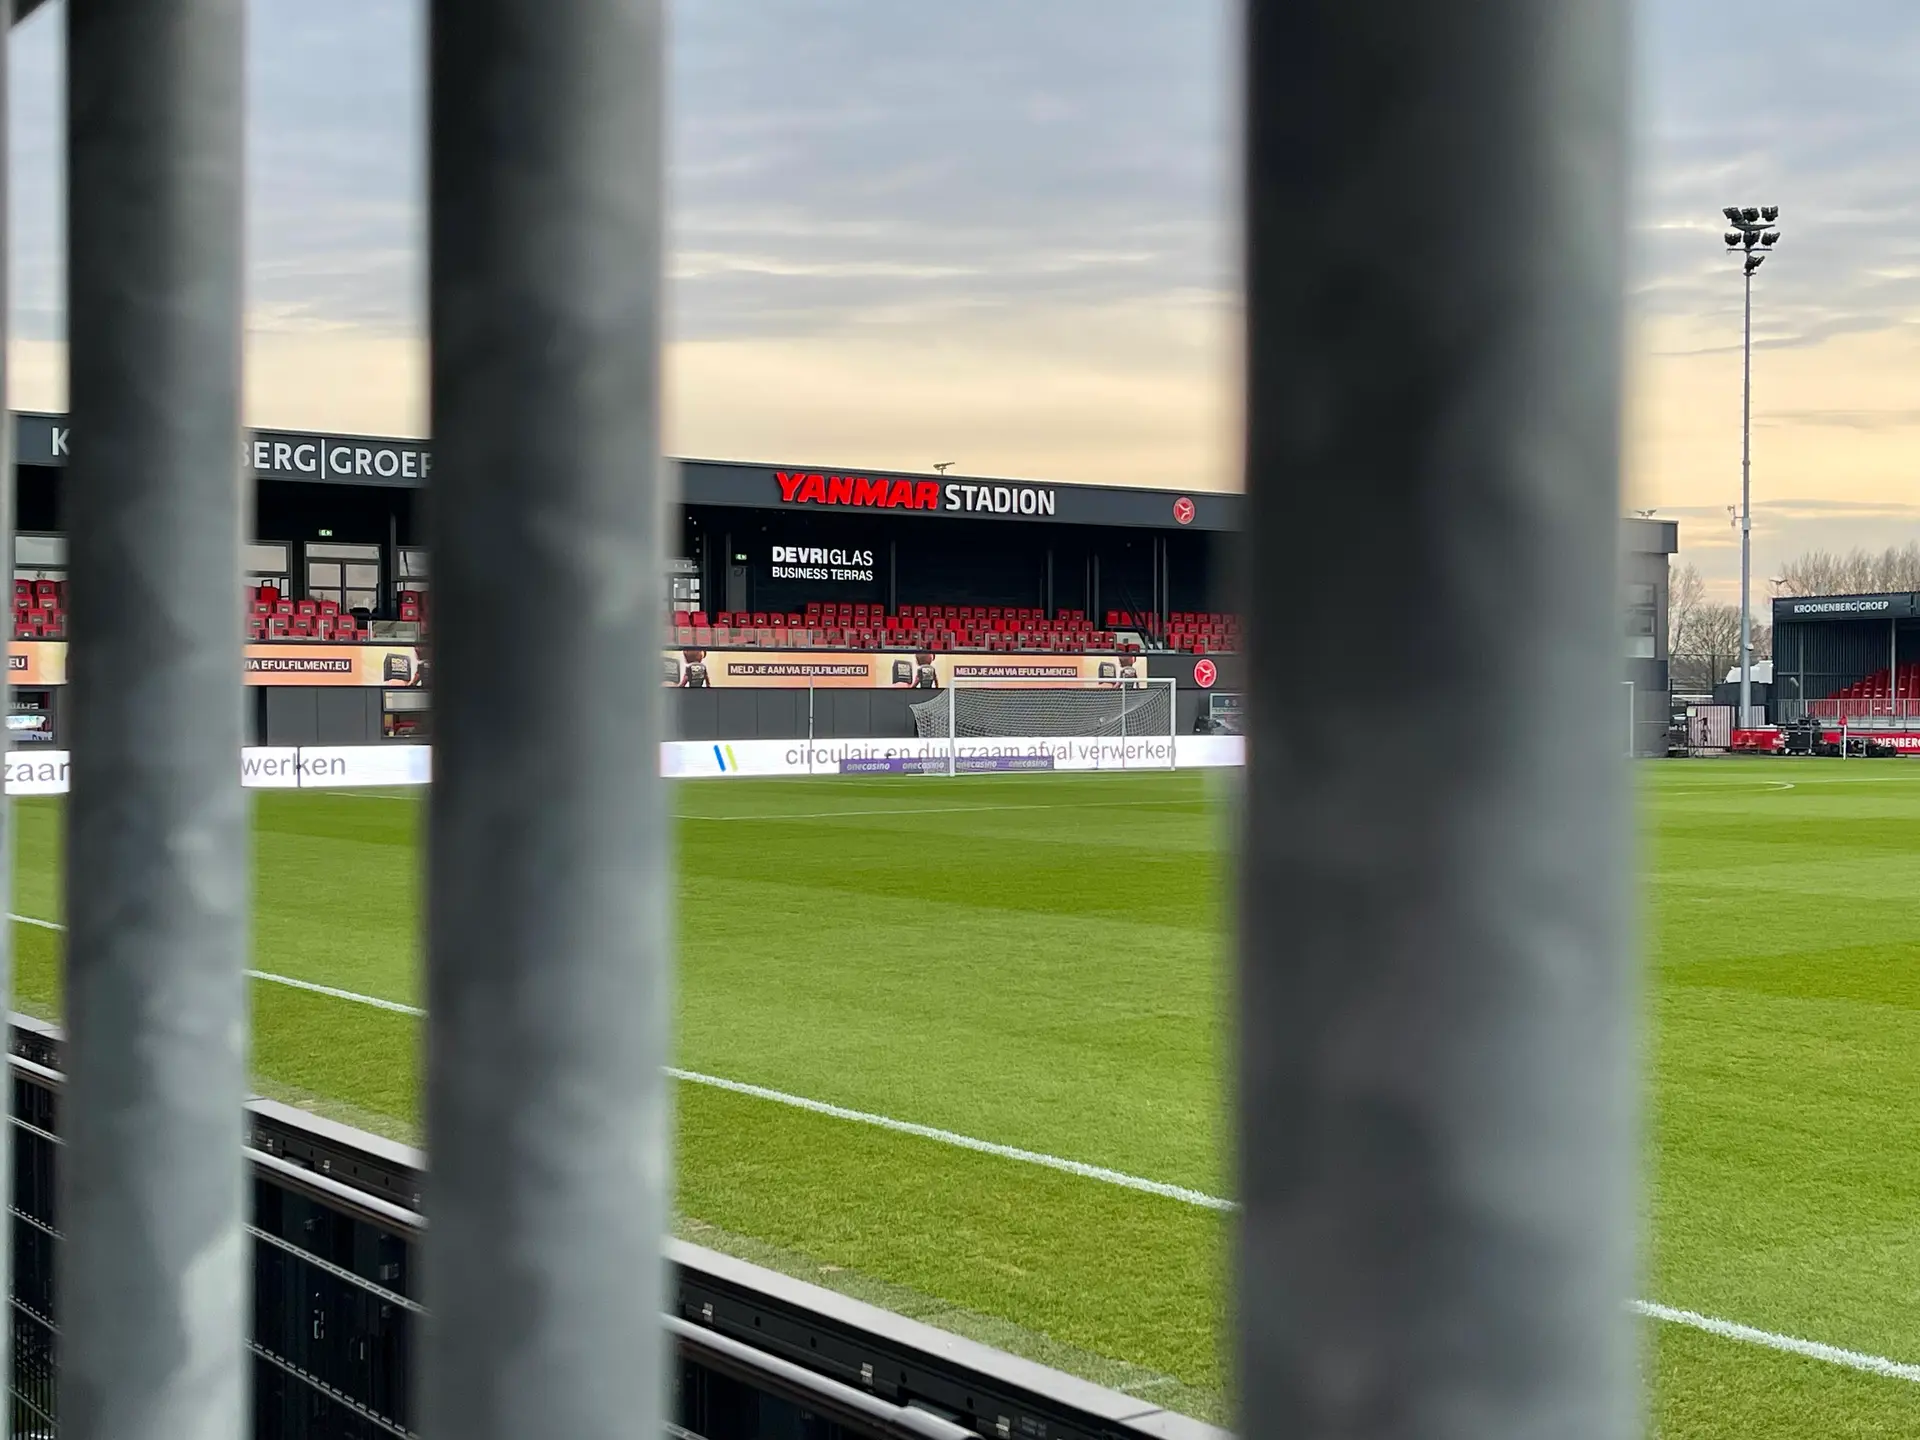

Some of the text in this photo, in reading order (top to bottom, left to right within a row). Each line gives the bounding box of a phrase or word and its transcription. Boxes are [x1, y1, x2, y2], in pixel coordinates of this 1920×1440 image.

[775, 471, 1055, 516] YANMAR STADION
[772, 567, 873, 581] BUSINESS TERRAS
[261, 660, 350, 671] EFULFILMENT.EU
[730, 665, 867, 675] MELD JE AAN VIA EFULFILMENT.EU
[956, 667, 977, 676] MELD
[978, 667, 987, 676] JE
[988, 668, 1004, 676] AAN
[1005, 668, 1017, 676] VIA
[786, 743, 879, 765] circulair
[1027, 740, 1072, 760] afval
[846, 762, 891, 771] onecasino
